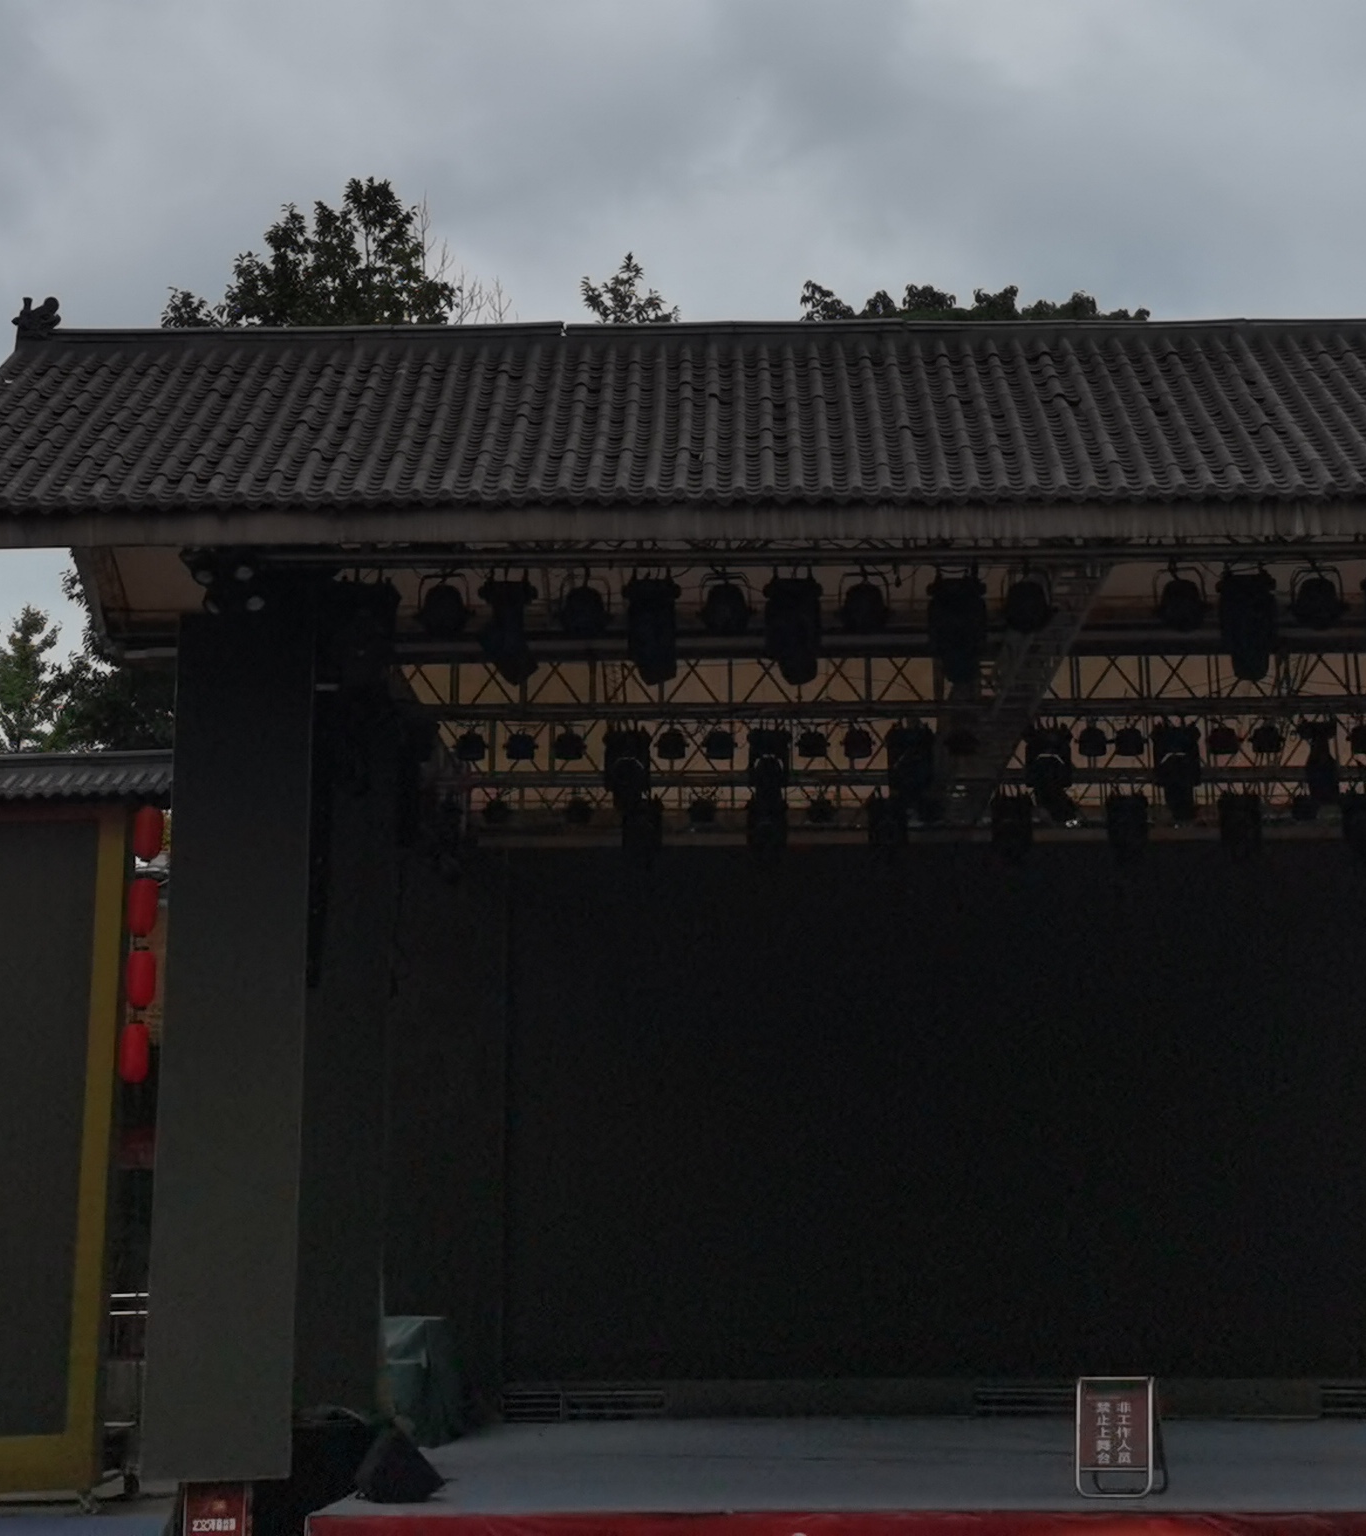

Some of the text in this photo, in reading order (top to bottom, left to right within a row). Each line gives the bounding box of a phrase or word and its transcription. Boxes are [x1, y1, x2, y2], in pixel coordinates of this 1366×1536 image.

[1116, 1401, 1132, 1464] 非工作人员
